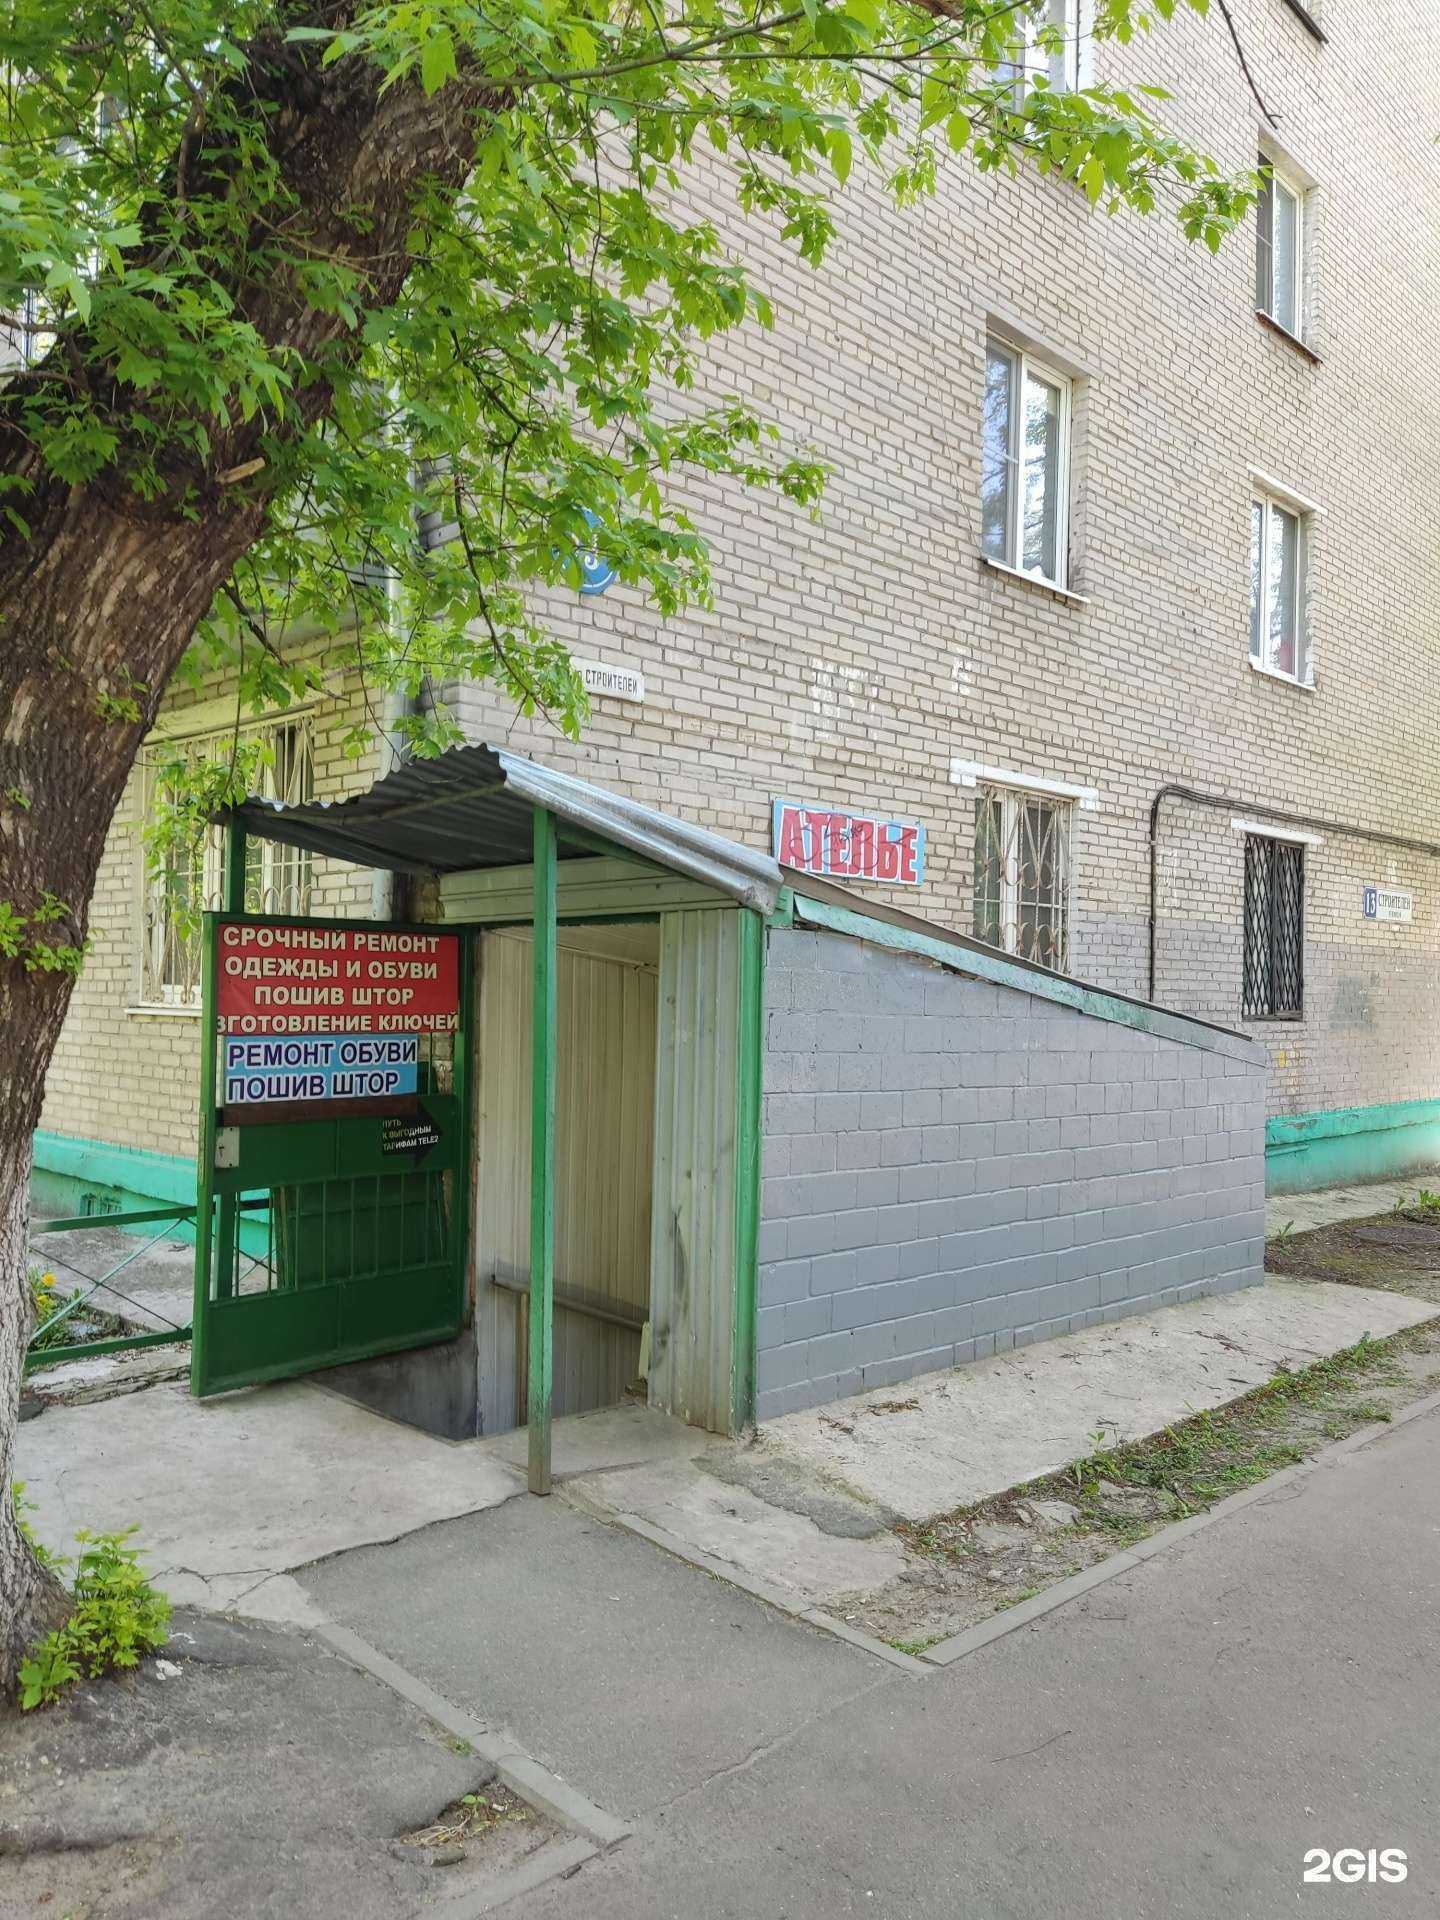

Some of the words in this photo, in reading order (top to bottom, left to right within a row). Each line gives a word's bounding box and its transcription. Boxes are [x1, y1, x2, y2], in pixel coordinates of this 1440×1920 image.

[778, 807, 918, 882] АТЕЛЬЕ
[223, 927, 346, 950] СРОЧНЫЙ
[353, 934, 440, 954] РЕМОНТ
[224, 956, 338, 980] ОДЕЖДЫ
[346, 960, 361, 978] И
[368, 961, 438, 979] ОБУВИ
[254, 986, 345, 1006] ПОШИВ
[352, 987, 414, 1006] ШТОР
[216, 1015, 372, 1033] ЗГОТОВЛЕНИЕ
[378, 1011, 459, 1031] КЛЮЧЕЙ
[228, 1042, 334, 1068] РЕМОНТ
[340, 1039, 417, 1064] ОБУВИ
[228, 1075, 325, 1101] ПОШИВ
[333, 1072, 399, 1095] ШТОР
[382, 1119, 402, 1128] ПУТЬ
[418, 1135, 439, 1146] TELE2
